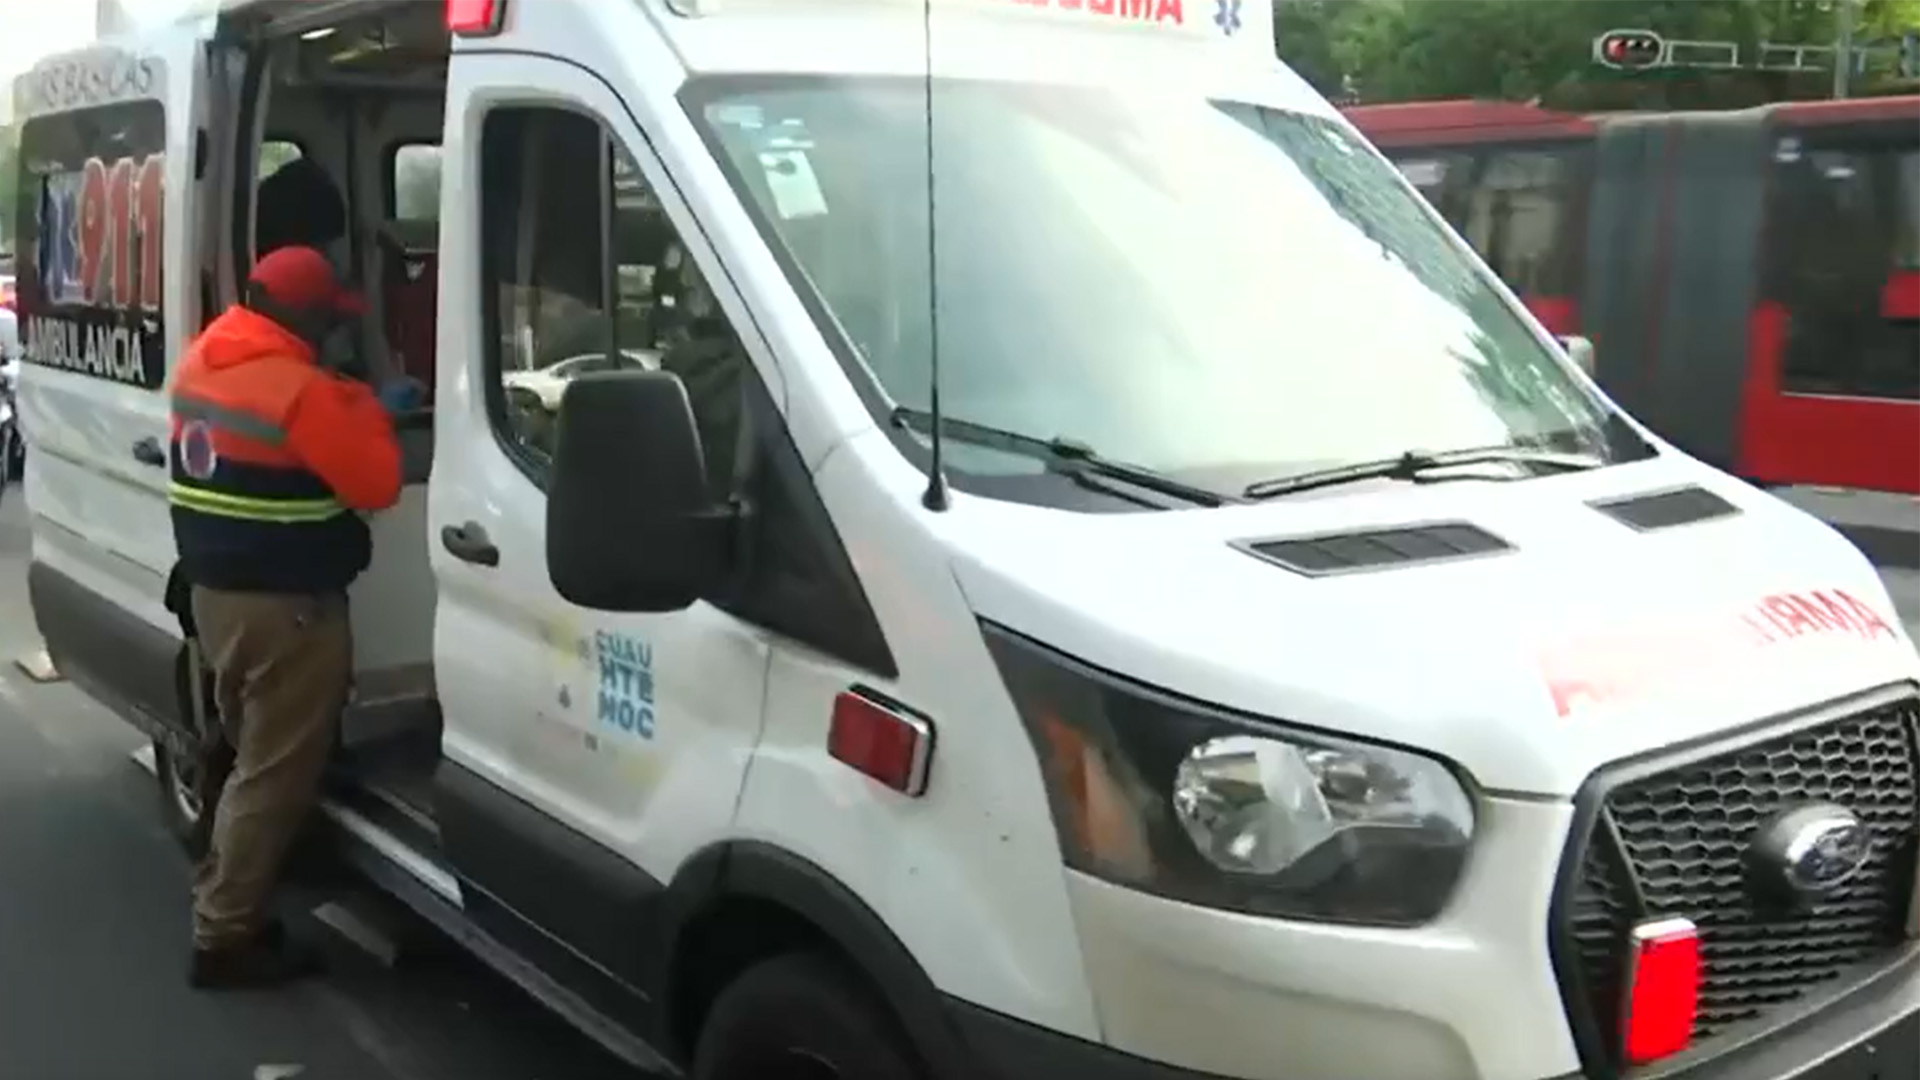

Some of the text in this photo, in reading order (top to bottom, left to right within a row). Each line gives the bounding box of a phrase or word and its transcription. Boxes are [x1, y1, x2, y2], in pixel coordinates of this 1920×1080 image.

[76, 154, 166, 311] 911
[26, 314, 146, 383] AMBULANCIA
[598, 689, 654, 740] MOC
